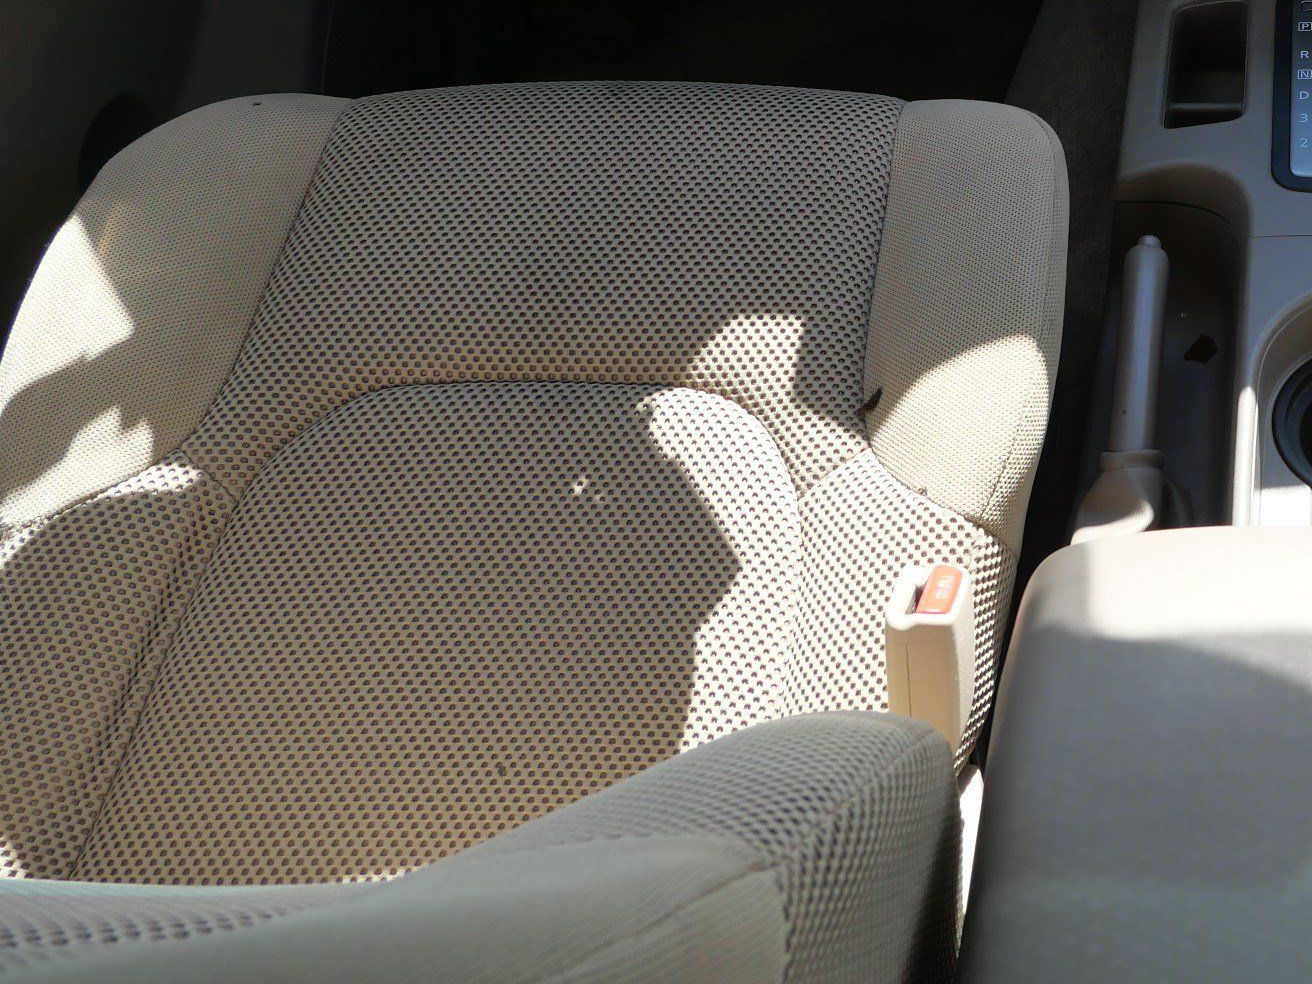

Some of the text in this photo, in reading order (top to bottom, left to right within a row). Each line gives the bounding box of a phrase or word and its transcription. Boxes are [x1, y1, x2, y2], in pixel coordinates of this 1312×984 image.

[1300, 50, 1309, 59] R
[1299, 91, 1309, 99] D
[1300, 113, 1308, 123] 3
[1300, 138, 1308, 147] 2
